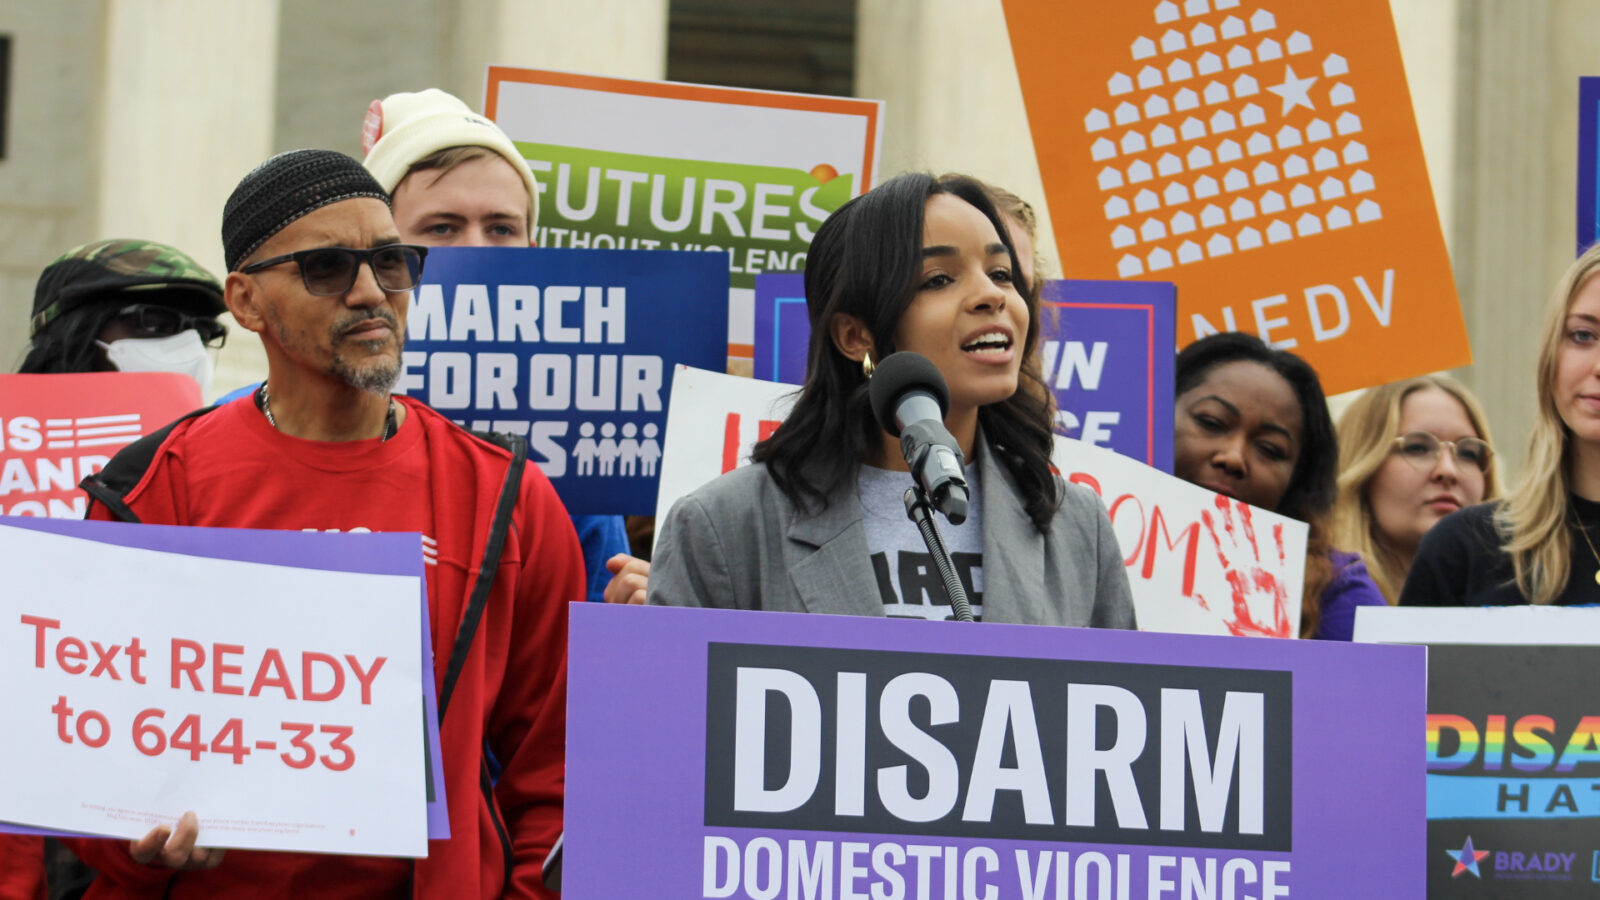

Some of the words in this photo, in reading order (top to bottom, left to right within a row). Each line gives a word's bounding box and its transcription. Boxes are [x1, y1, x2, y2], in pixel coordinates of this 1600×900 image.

[405, 284, 626, 343] MARCH
[391, 352, 518, 410] FOR
[529, 353, 663, 412] OUR
[21, 613, 147, 685] Text
[170, 638, 388, 705] READY
[51, 695, 111, 748] to
[132, 708, 356, 772] 644-33
[734, 666, 1264, 835] DISARM
[702, 835, 1000, 900] DOMESTIC
[1015, 848, 1292, 900] VIOLENCE
[1494, 851, 1577, 873] BRADY
